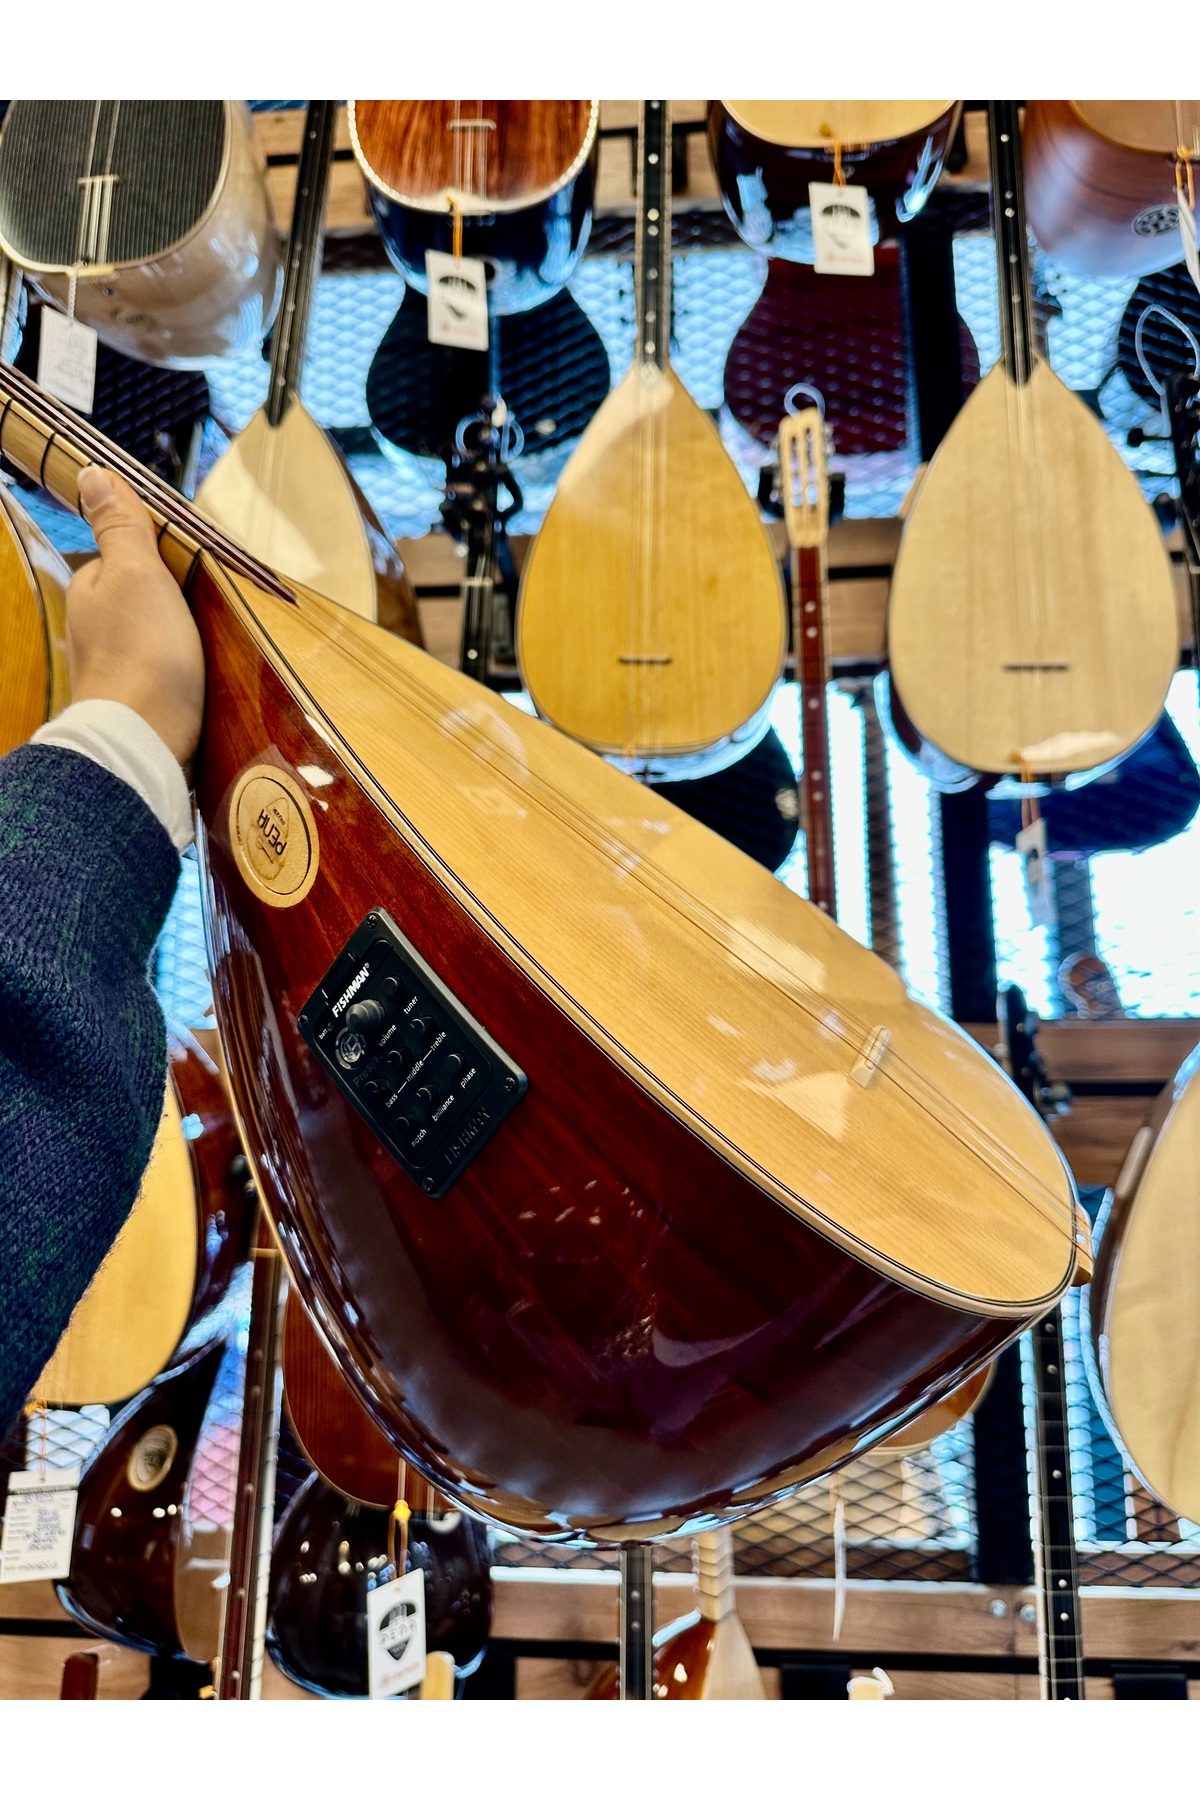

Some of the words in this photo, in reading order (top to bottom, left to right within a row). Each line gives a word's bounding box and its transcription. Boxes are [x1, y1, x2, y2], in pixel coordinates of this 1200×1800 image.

[257, 809, 287, 855] PENA
[378, 1024, 397, 1047] volume
[403, 995, 419, 1015] tuner
[385, 1093, 398, 1108] bass
[406, 1059, 425, 1082] middle
[430, 1030, 447, 1051] treble
[411, 1128, 427, 1147] notch
[432, 1094, 455, 1122] brilliance
[460, 1067, 476, 1089] phase
